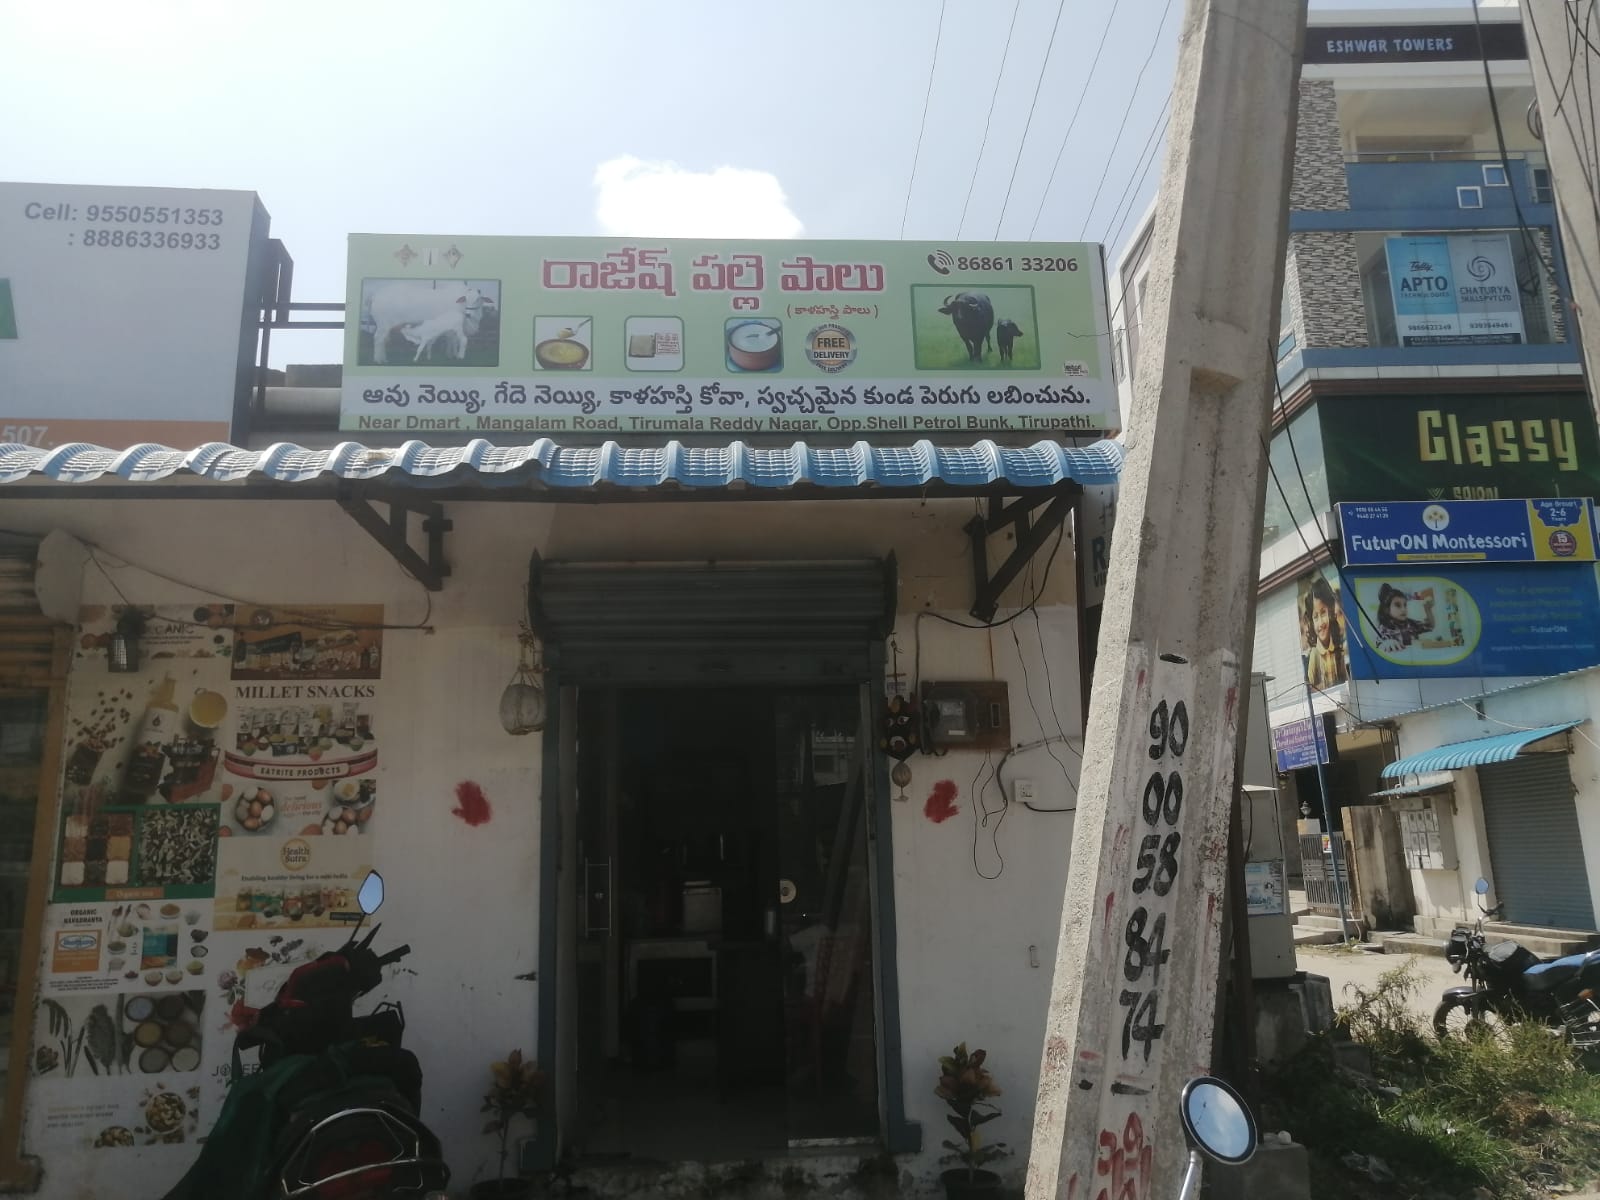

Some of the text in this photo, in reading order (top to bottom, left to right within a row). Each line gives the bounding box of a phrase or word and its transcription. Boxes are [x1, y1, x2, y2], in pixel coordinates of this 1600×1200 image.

[1326, 38, 1454, 54] ESHWAR TOWERS
[24, 202, 224, 226] Cell: 9550551353
[83, 229, 221, 251] 8886336933
[957, 256, 1078, 272] 86861 33206
[543, 247, 885, 310] రాజేష్ పల్లె పాలు
[1401, 276, 1448, 291] APTO
[1459, 286, 1511, 295] CHATURYA
[817, 337, 845, 348] FREE
[813, 351, 850, 359] DELIVERY
[362, 384, 410, 407] ఆవు
[494, 381, 527, 404] గేదె
[609, 384, 693, 414] కాళహస్తి
[863, 385, 915, 405] కుండ
[919, 385, 981, 405] పెరుగు
[358, 415, 401, 429] Near
[476, 415, 566, 431] Mangalam
[572, 416, 623, 431] Road,
[629, 416, 704, 430] Tirumala
[710, 416, 763, 432] Reddy
[769, 416, 822, 432] Nagar,
[827, 415, 907, 432] Opp.Shell
[913, 415, 961, 429] Petrol
[966, 415, 1014, 430] Bunk,
[1018, 415, 1096, 431] Tirupathi.
[1417, 409, 1579, 471] Classy
[1549, 507, 1567, 517] 2-6
[1351, 532, 1528, 551] FuturON Montessori
[235, 684, 375, 699] MILLET SNACKS
[1148, 700, 1190, 760] 90
[297, 766, 341, 776] PRODUCTS
[1142, 770, 1183, 827] 00
[1132, 831, 1181, 897] 58
[1123, 906, 1170, 983] 84
[1118, 989, 1166, 1062] 74
